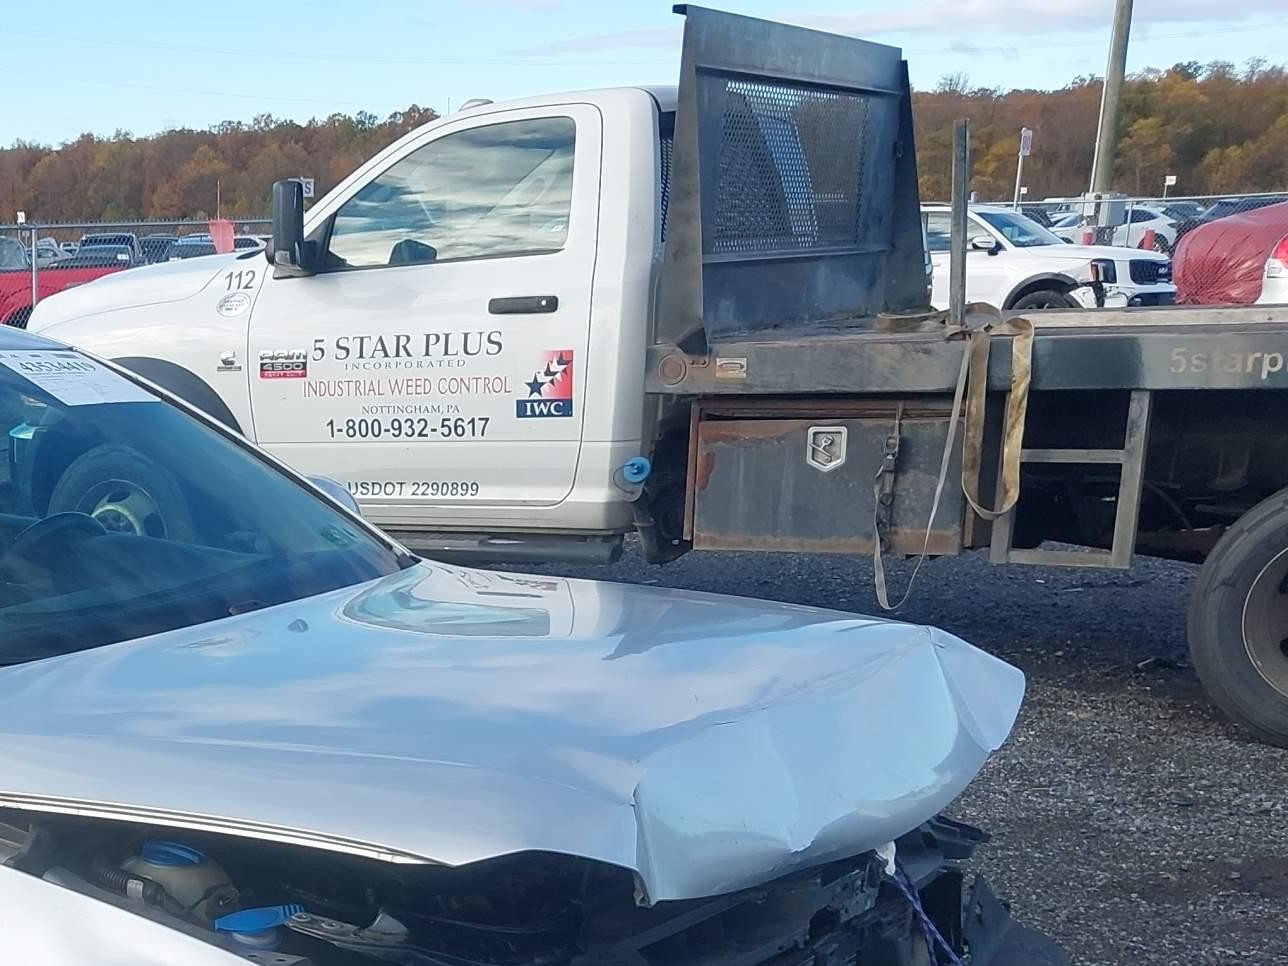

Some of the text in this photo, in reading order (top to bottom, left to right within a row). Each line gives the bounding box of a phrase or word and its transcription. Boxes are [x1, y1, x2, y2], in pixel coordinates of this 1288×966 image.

[304, 181, 312, 194] S
[225, 270, 256, 291] 112
[312, 330, 503, 361] 5 STAR PLUS
[263, 362, 304, 371] 4500
[345, 359, 466, 371] INCORPORATED
[1169, 347, 1288, 380] 5starp
[303, 375, 512, 398] INDUSTRIAL WEED CONTROL
[362, 404, 460, 415] NOTTINGHAM, PA
[526, 402, 563, 416] IWC
[326, 417, 490, 438] 1-800-932-5617
[348, 481, 479, 497] USDOT 2290899
